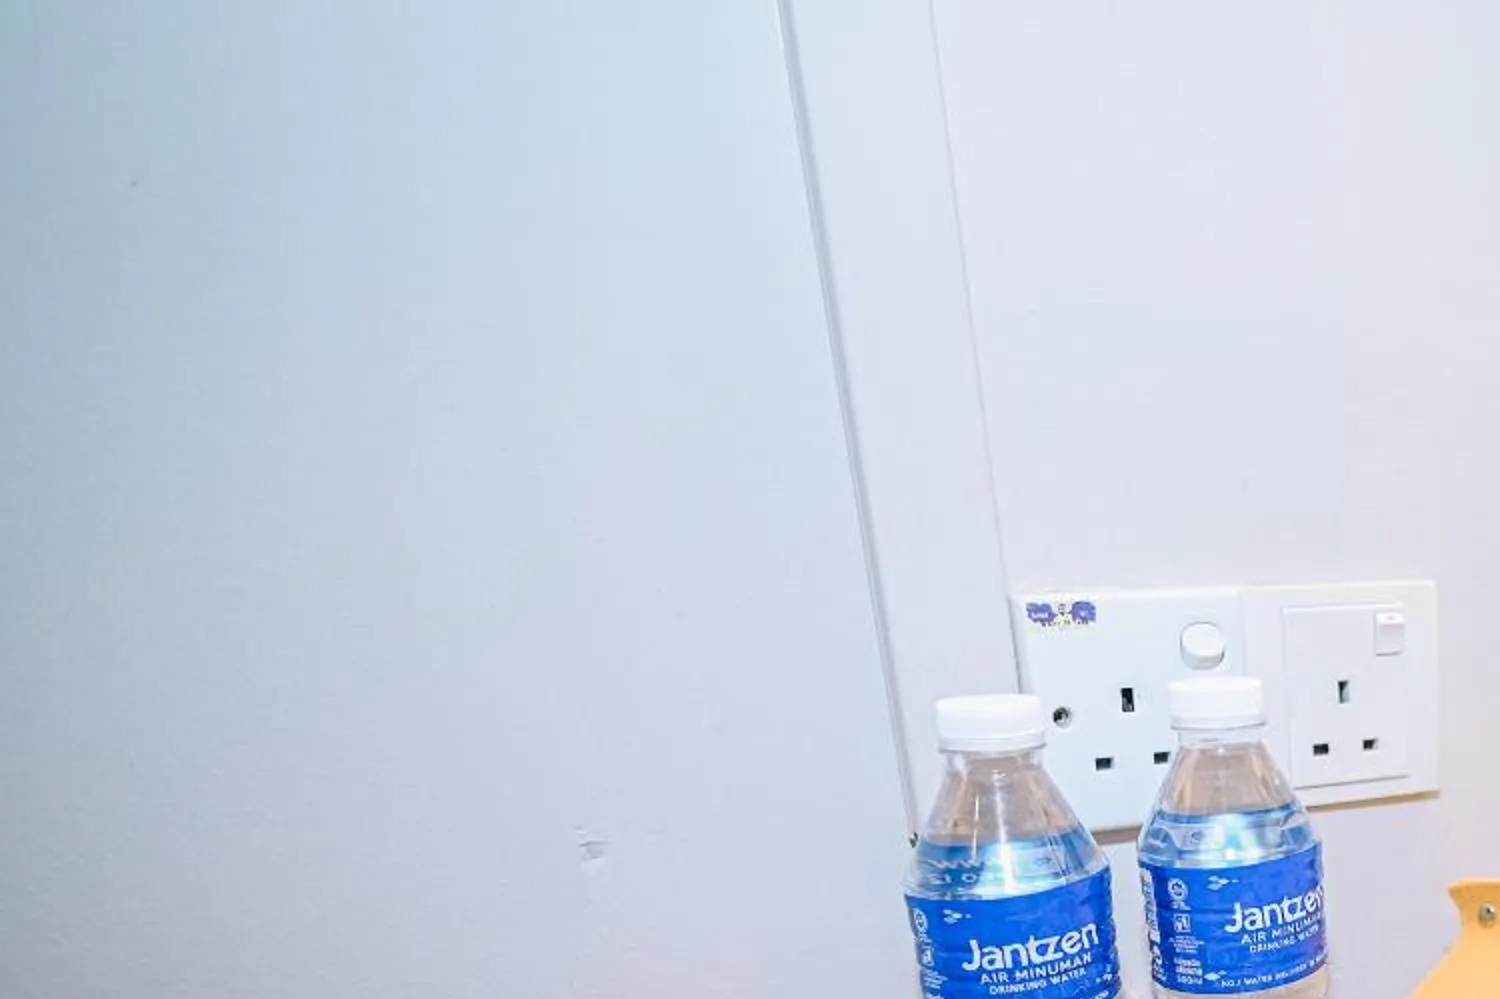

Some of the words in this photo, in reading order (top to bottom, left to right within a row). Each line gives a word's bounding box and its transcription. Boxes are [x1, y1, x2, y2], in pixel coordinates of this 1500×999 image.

[961, 922, 1099, 971] Jantzen
[1241, 931, 1267, 945] AIR
[980, 971, 1009, 985] AIR
[1015, 952, 1092, 981] MINUMAN
[989, 979, 1047, 995] DRINKING
[1051, 968, 1087, 985] WATER
